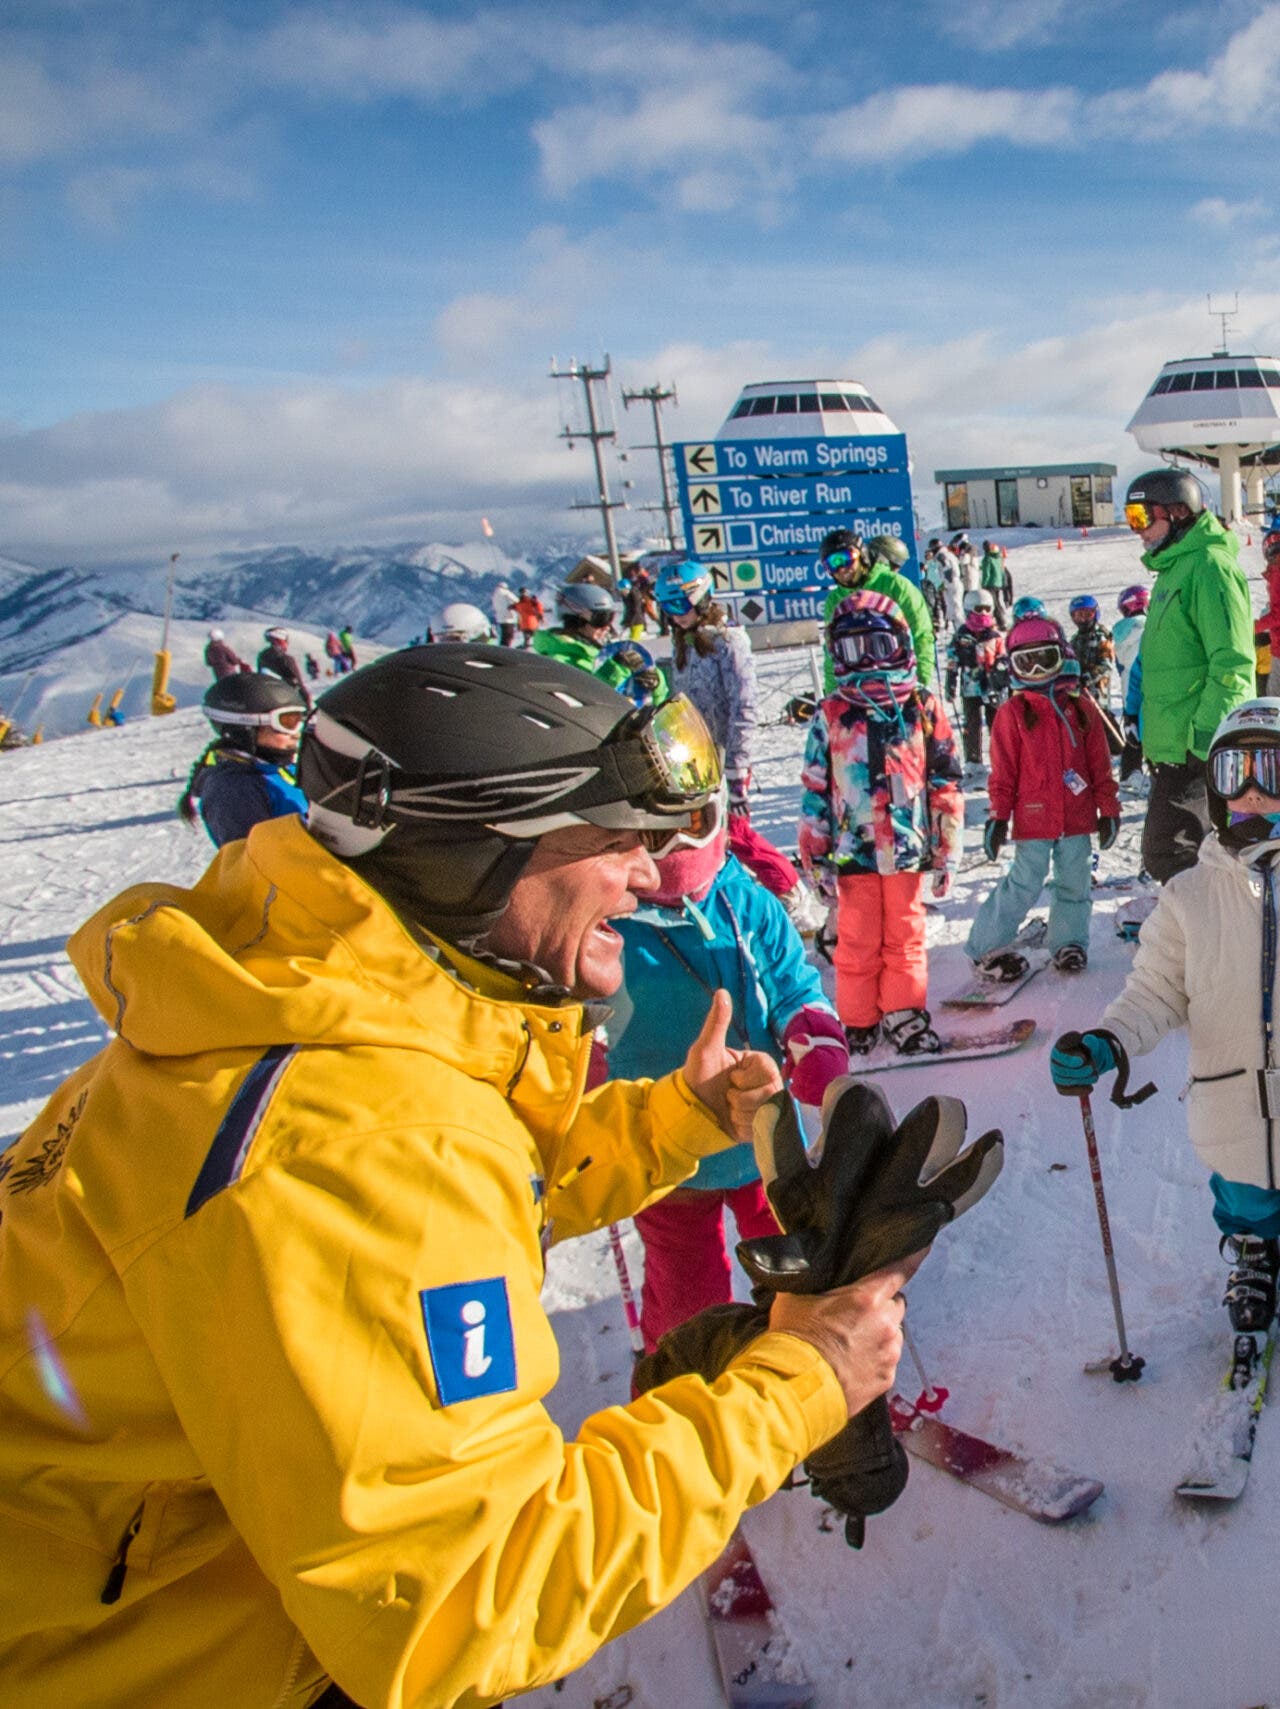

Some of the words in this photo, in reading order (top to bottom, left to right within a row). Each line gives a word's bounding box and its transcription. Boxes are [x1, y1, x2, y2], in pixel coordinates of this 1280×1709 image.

[723, 447, 747, 468] To
[754, 445, 809, 467] Warm
[816, 442, 888, 468] Springs
[729, 487, 753, 508] To
[760, 485, 809, 506] River
[815, 482, 852, 504] Run
[760, 523, 846, 546] Christm
[854, 518, 902, 539] Ridge
[765, 563, 809, 586] Upper
[769, 597, 826, 619] Little
